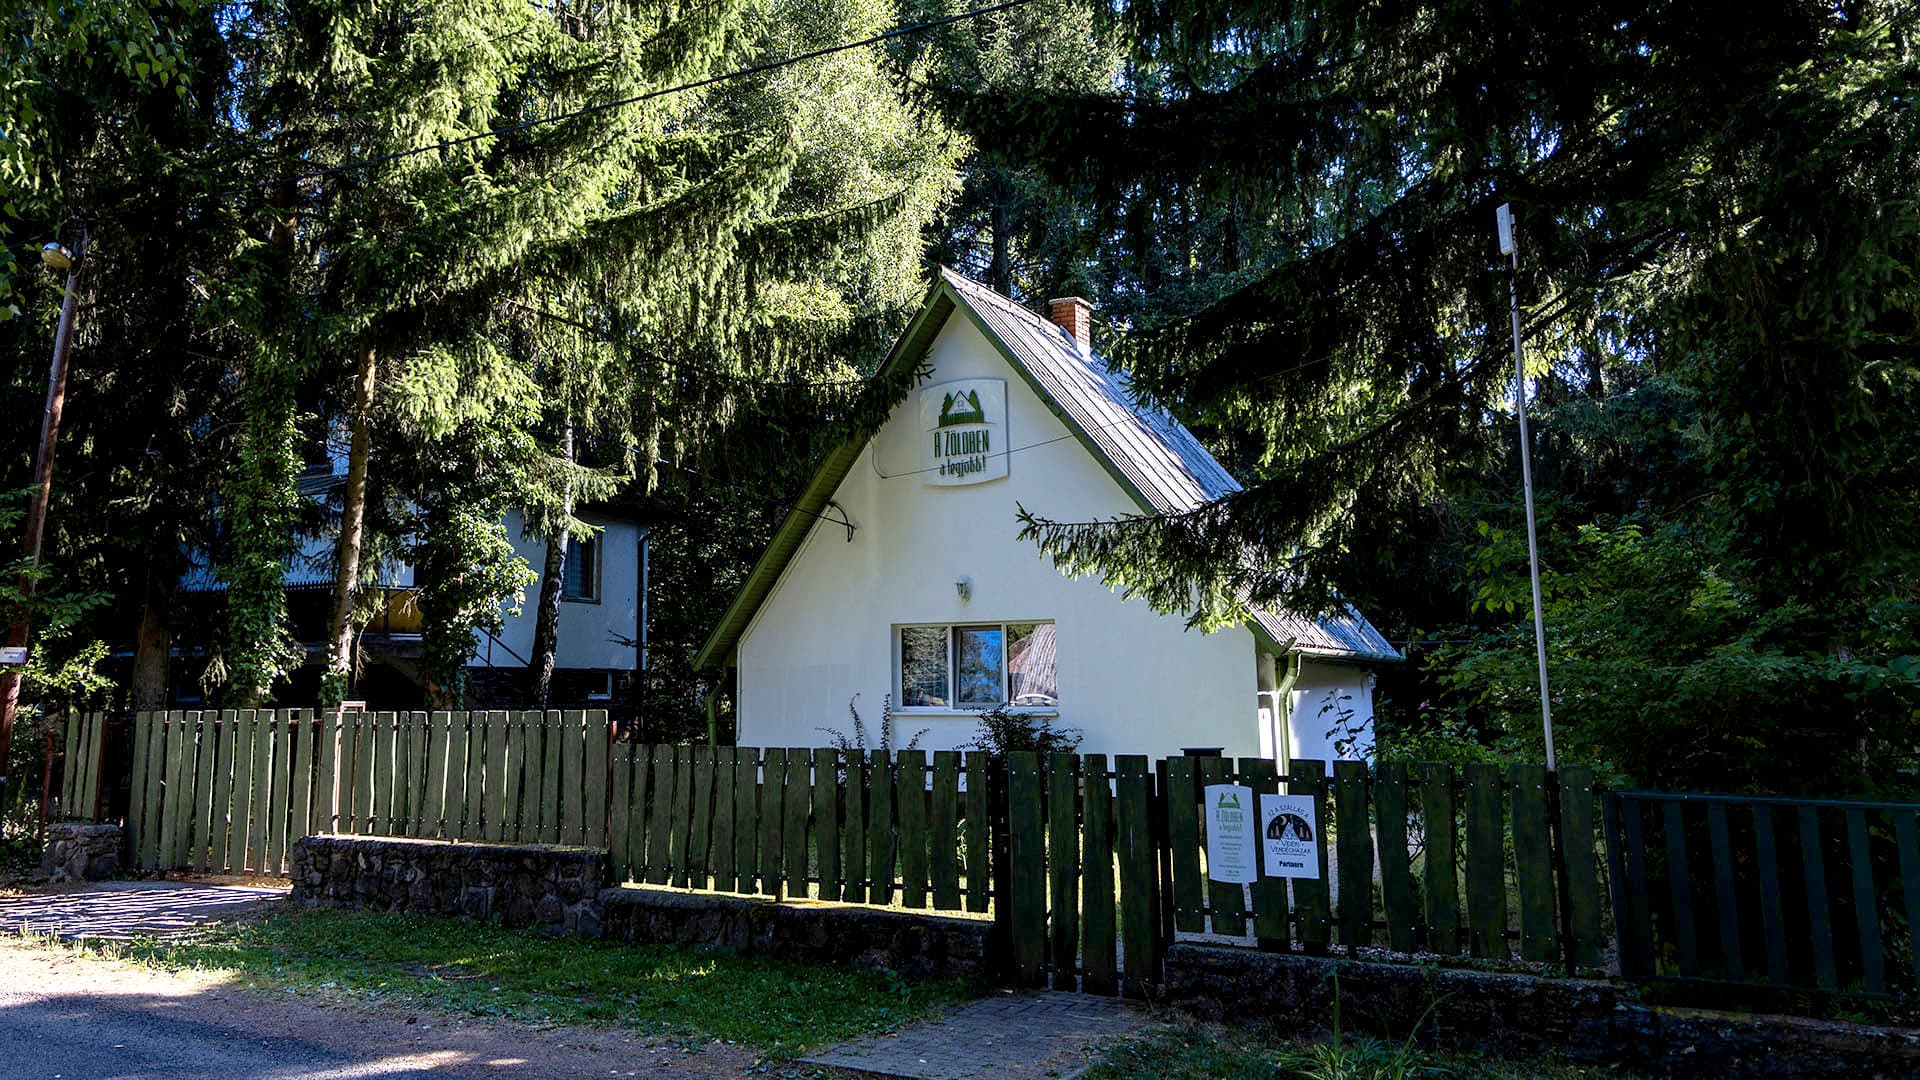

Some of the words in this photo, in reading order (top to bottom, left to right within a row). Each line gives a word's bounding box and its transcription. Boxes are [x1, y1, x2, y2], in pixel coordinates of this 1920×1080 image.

[934, 431, 941, 458] A
[944, 429, 990, 457] ZÖLDBEN
[940, 464, 945, 476] a
[947, 454, 986, 478] legjobb!
